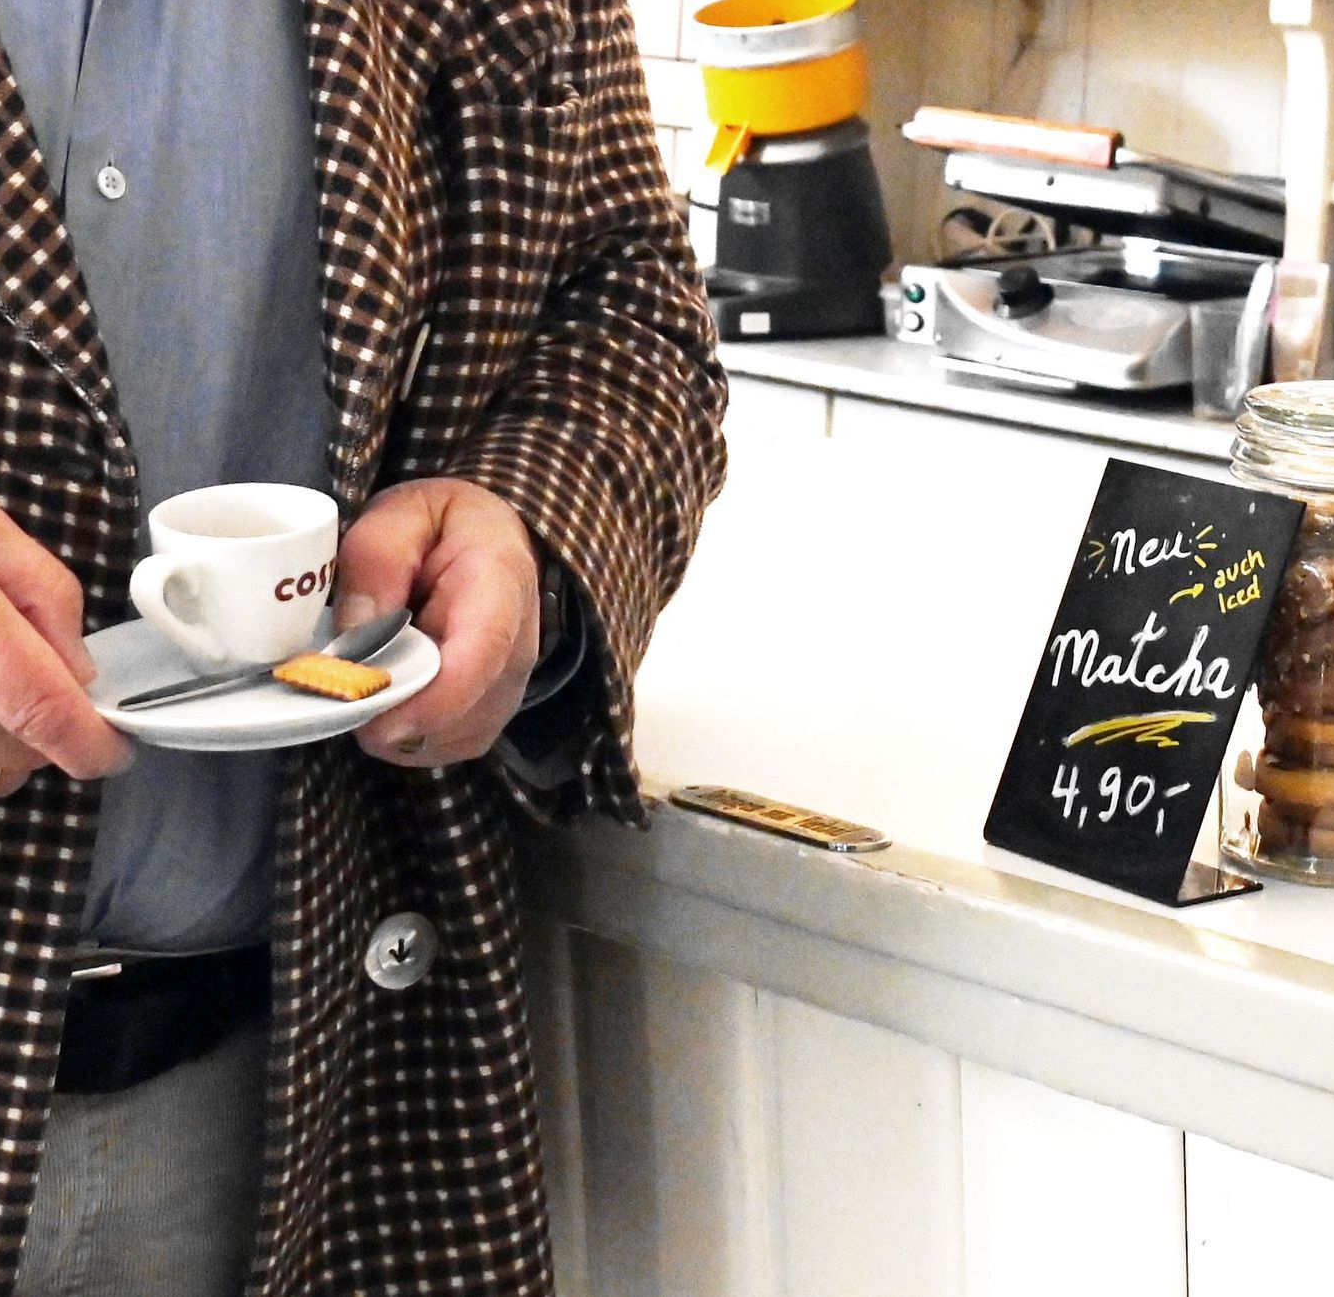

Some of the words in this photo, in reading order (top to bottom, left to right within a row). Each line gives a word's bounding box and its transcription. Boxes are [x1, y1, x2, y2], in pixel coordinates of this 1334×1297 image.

[1110, 528, 1191, 574] Neu
[1214, 549, 1265, 589] auch
[1218, 578, 1262, 613] Iced
[1049, 612, 1236, 700] Matcha
